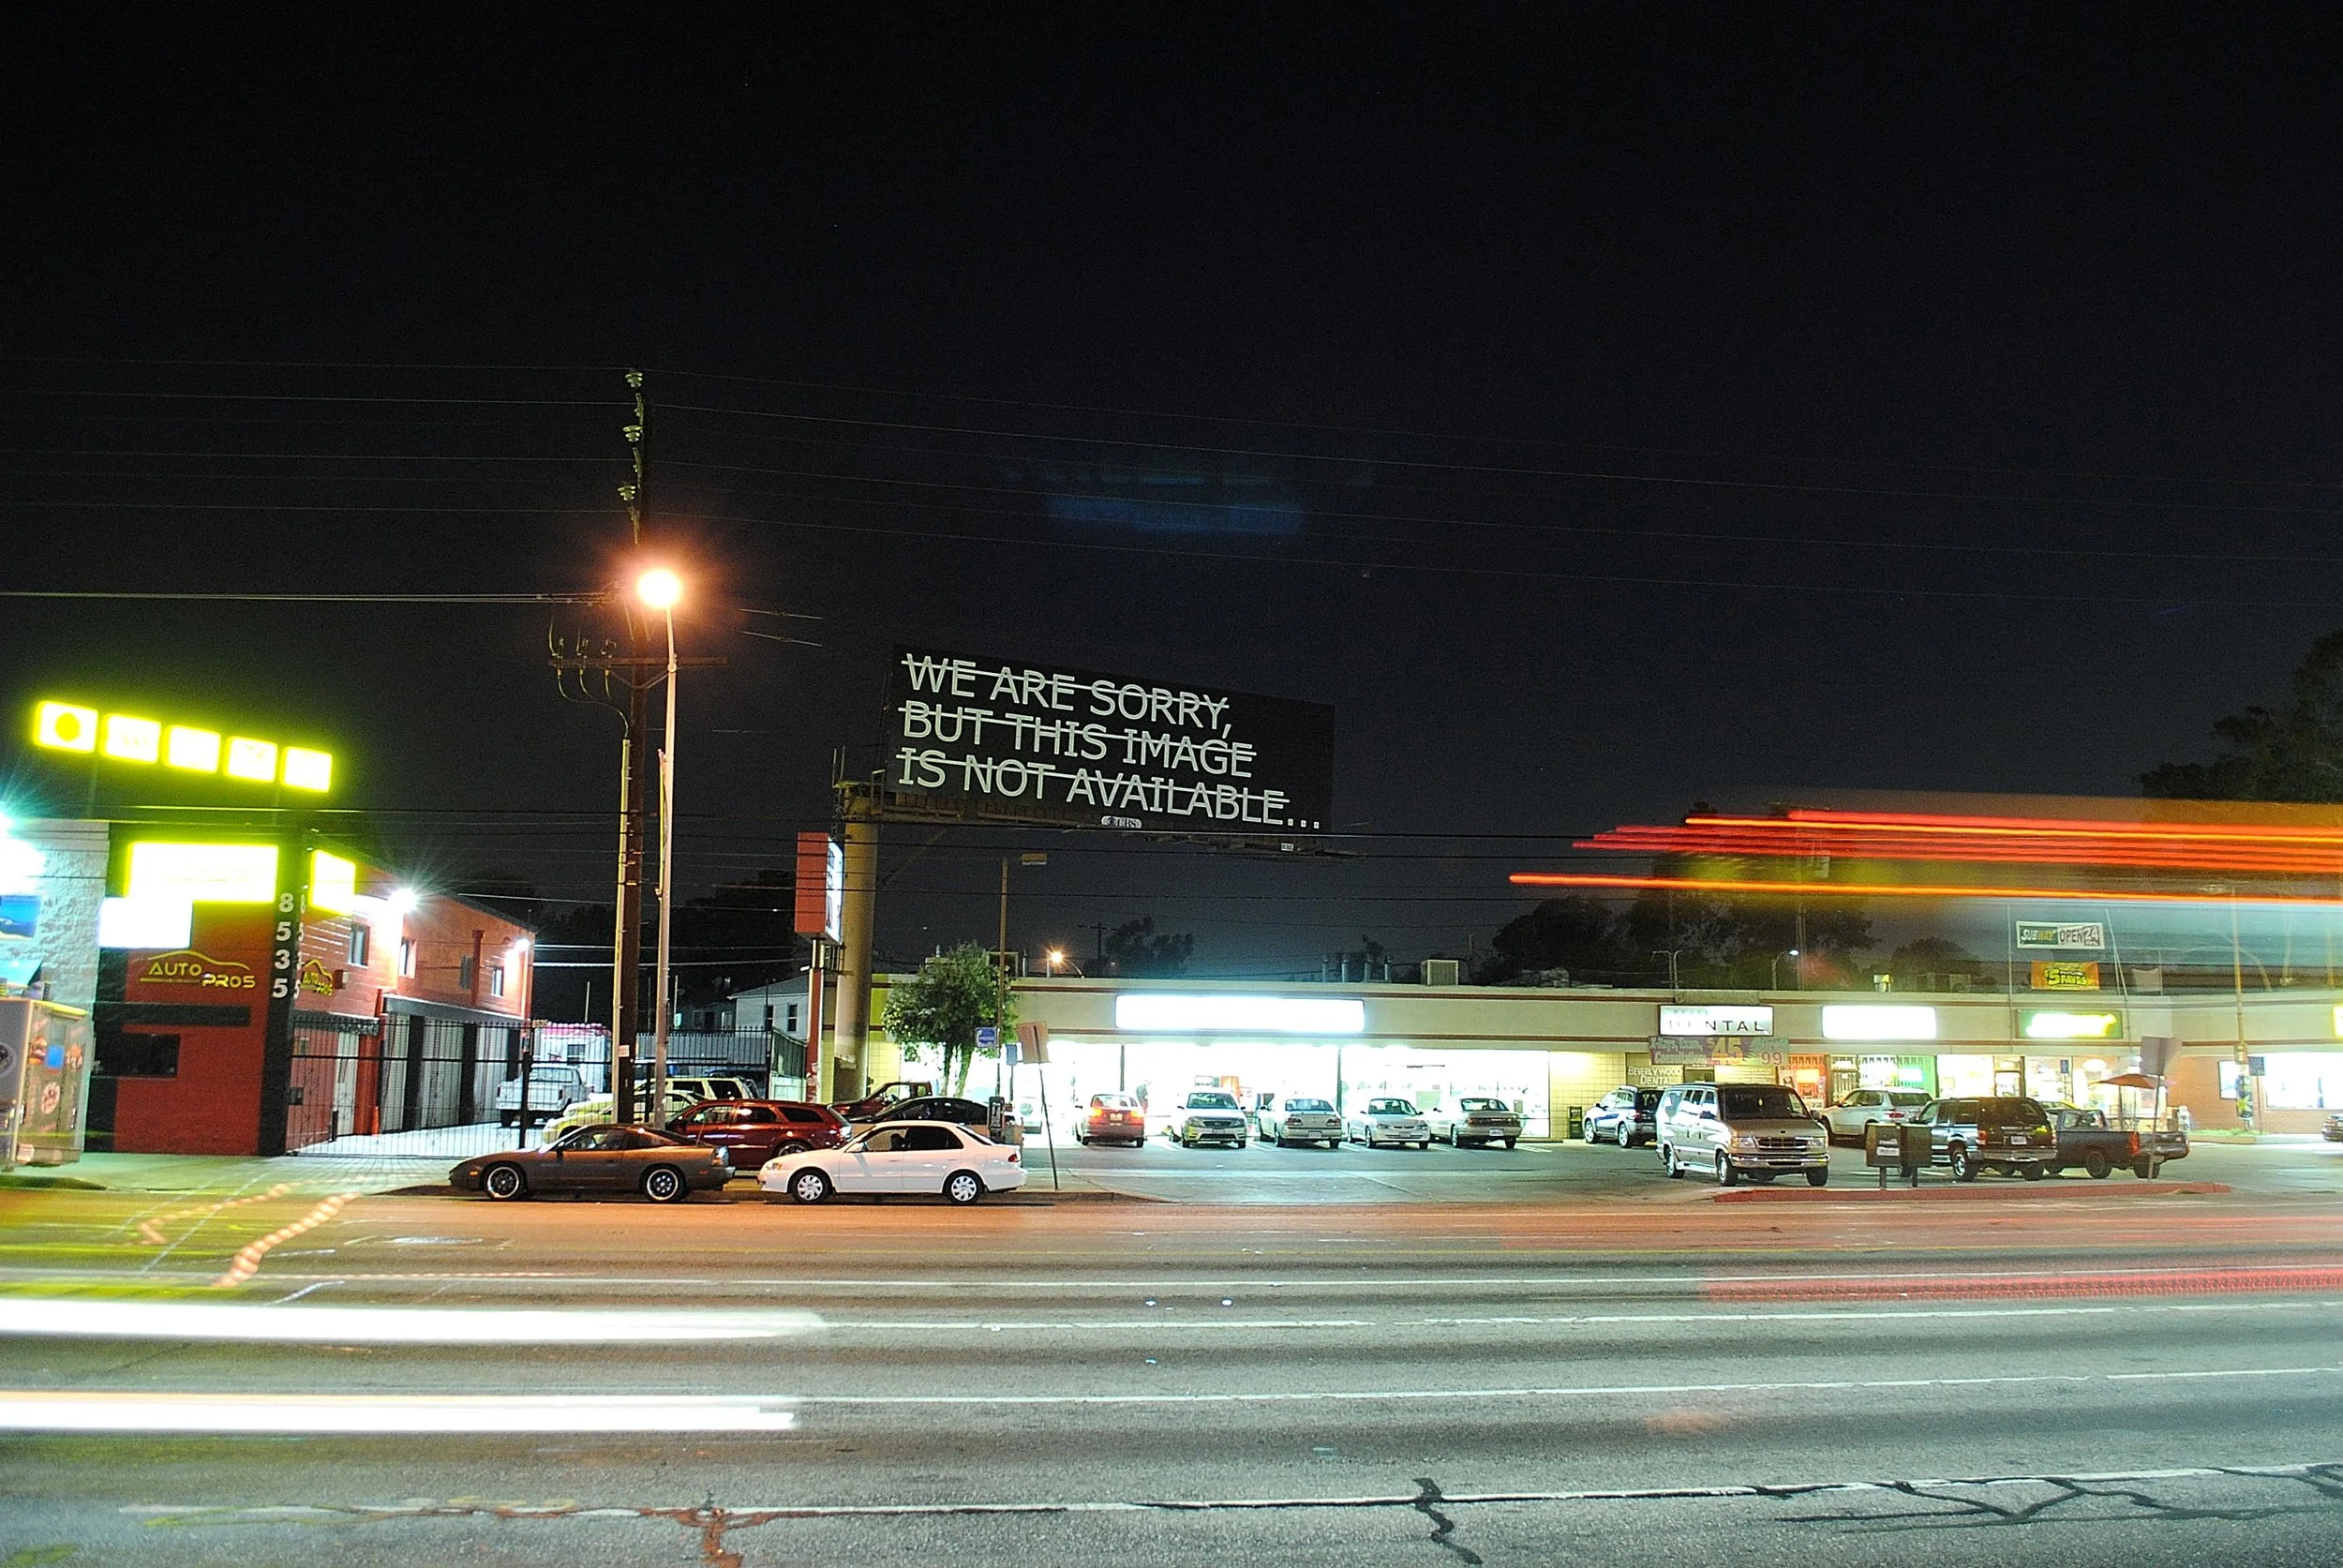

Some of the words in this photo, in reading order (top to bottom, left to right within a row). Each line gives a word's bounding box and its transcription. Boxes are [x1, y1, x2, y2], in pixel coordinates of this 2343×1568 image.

[906, 653, 976, 697] WE
[990, 666, 1075, 710] ARE
[1090, 679, 1231, 739] SORRY,
[903, 700, 993, 745] BUT
[1005, 712, 1107, 760] THIS
[1123, 728, 1253, 778] IMAGE
[899, 747, 946, 787] IS
[963, 754, 1055, 799] NOT
[1066, 769, 1320, 829] AVAILABLE...
[2022, 929, 2056, 941] SUBWAY
[2059, 929, 2083, 946] OPEN
[149, 962, 202, 976] AUTO
[202, 975, 256, 988] PROS
[1640, 1075, 1673, 1084] DENTAL
